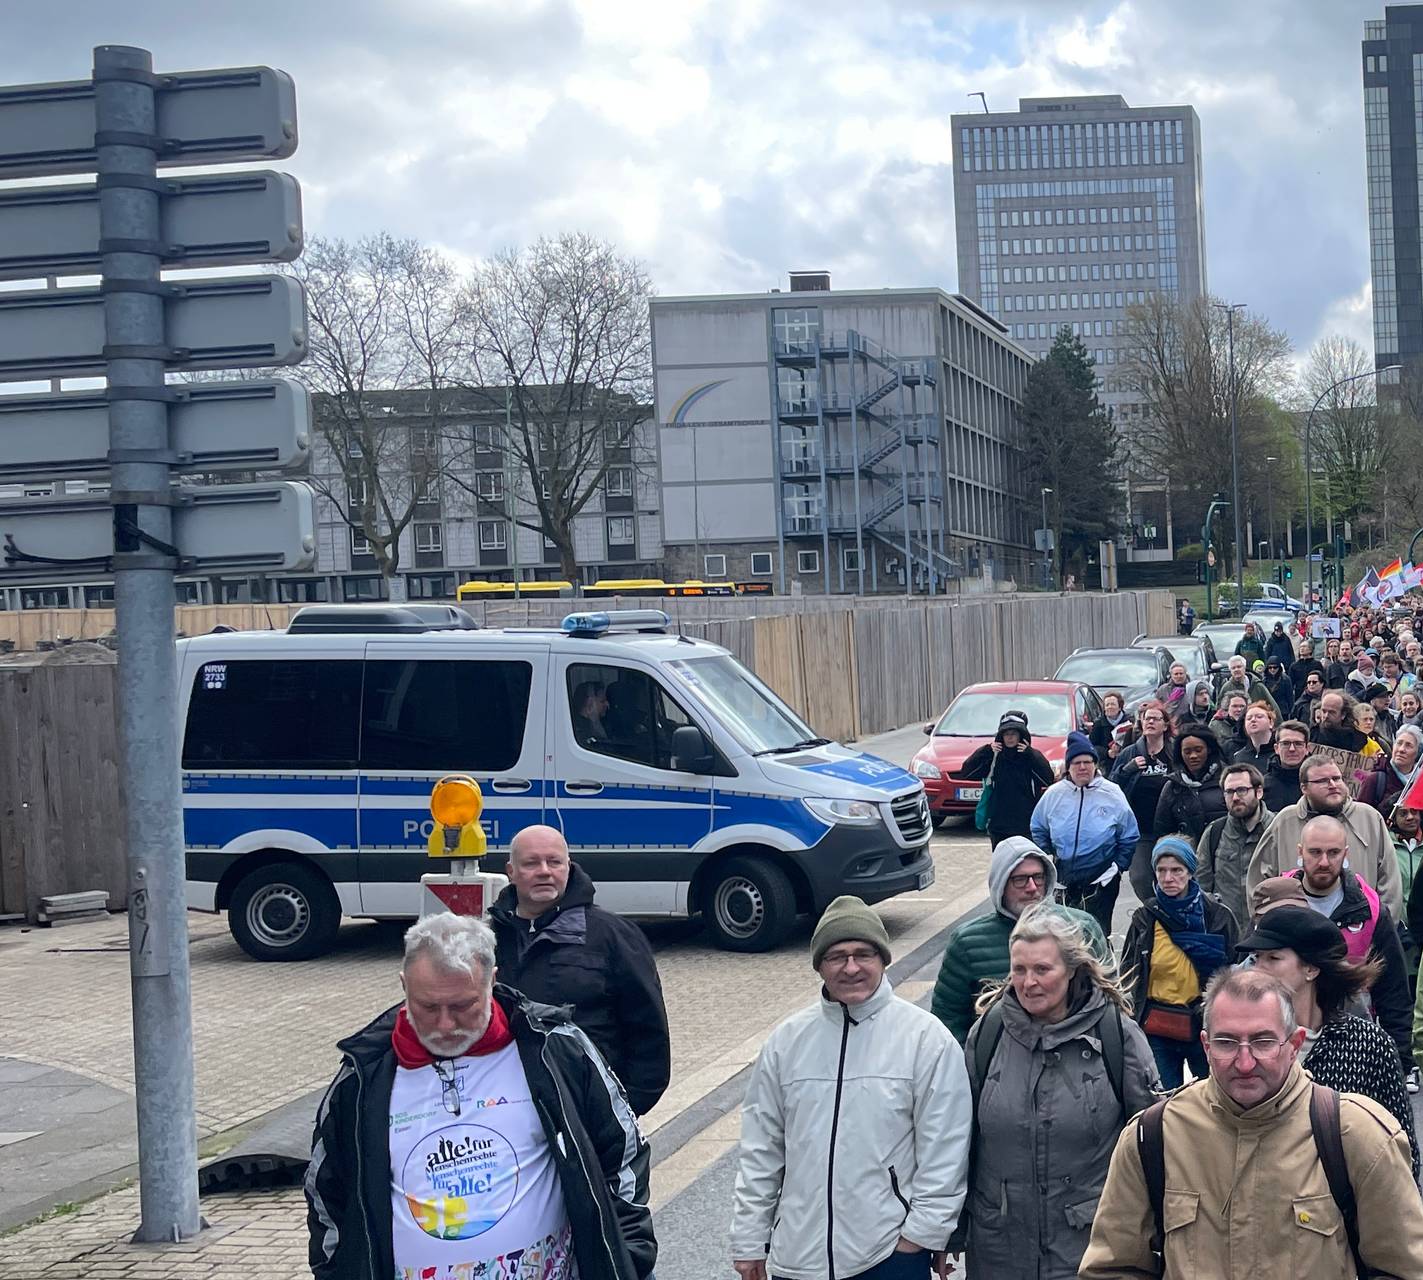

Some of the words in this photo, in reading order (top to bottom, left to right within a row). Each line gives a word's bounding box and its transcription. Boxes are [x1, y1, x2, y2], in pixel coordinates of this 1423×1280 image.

[204, 664, 227, 673] NRW
[204, 673, 226, 681] 2733
[425, 1150, 497, 1174] Menschenrechte
[427, 1135, 473, 1166] alle!
[426, 1160, 498, 1182] Menschenrechte
[448, 1173, 492, 1198] alle!
